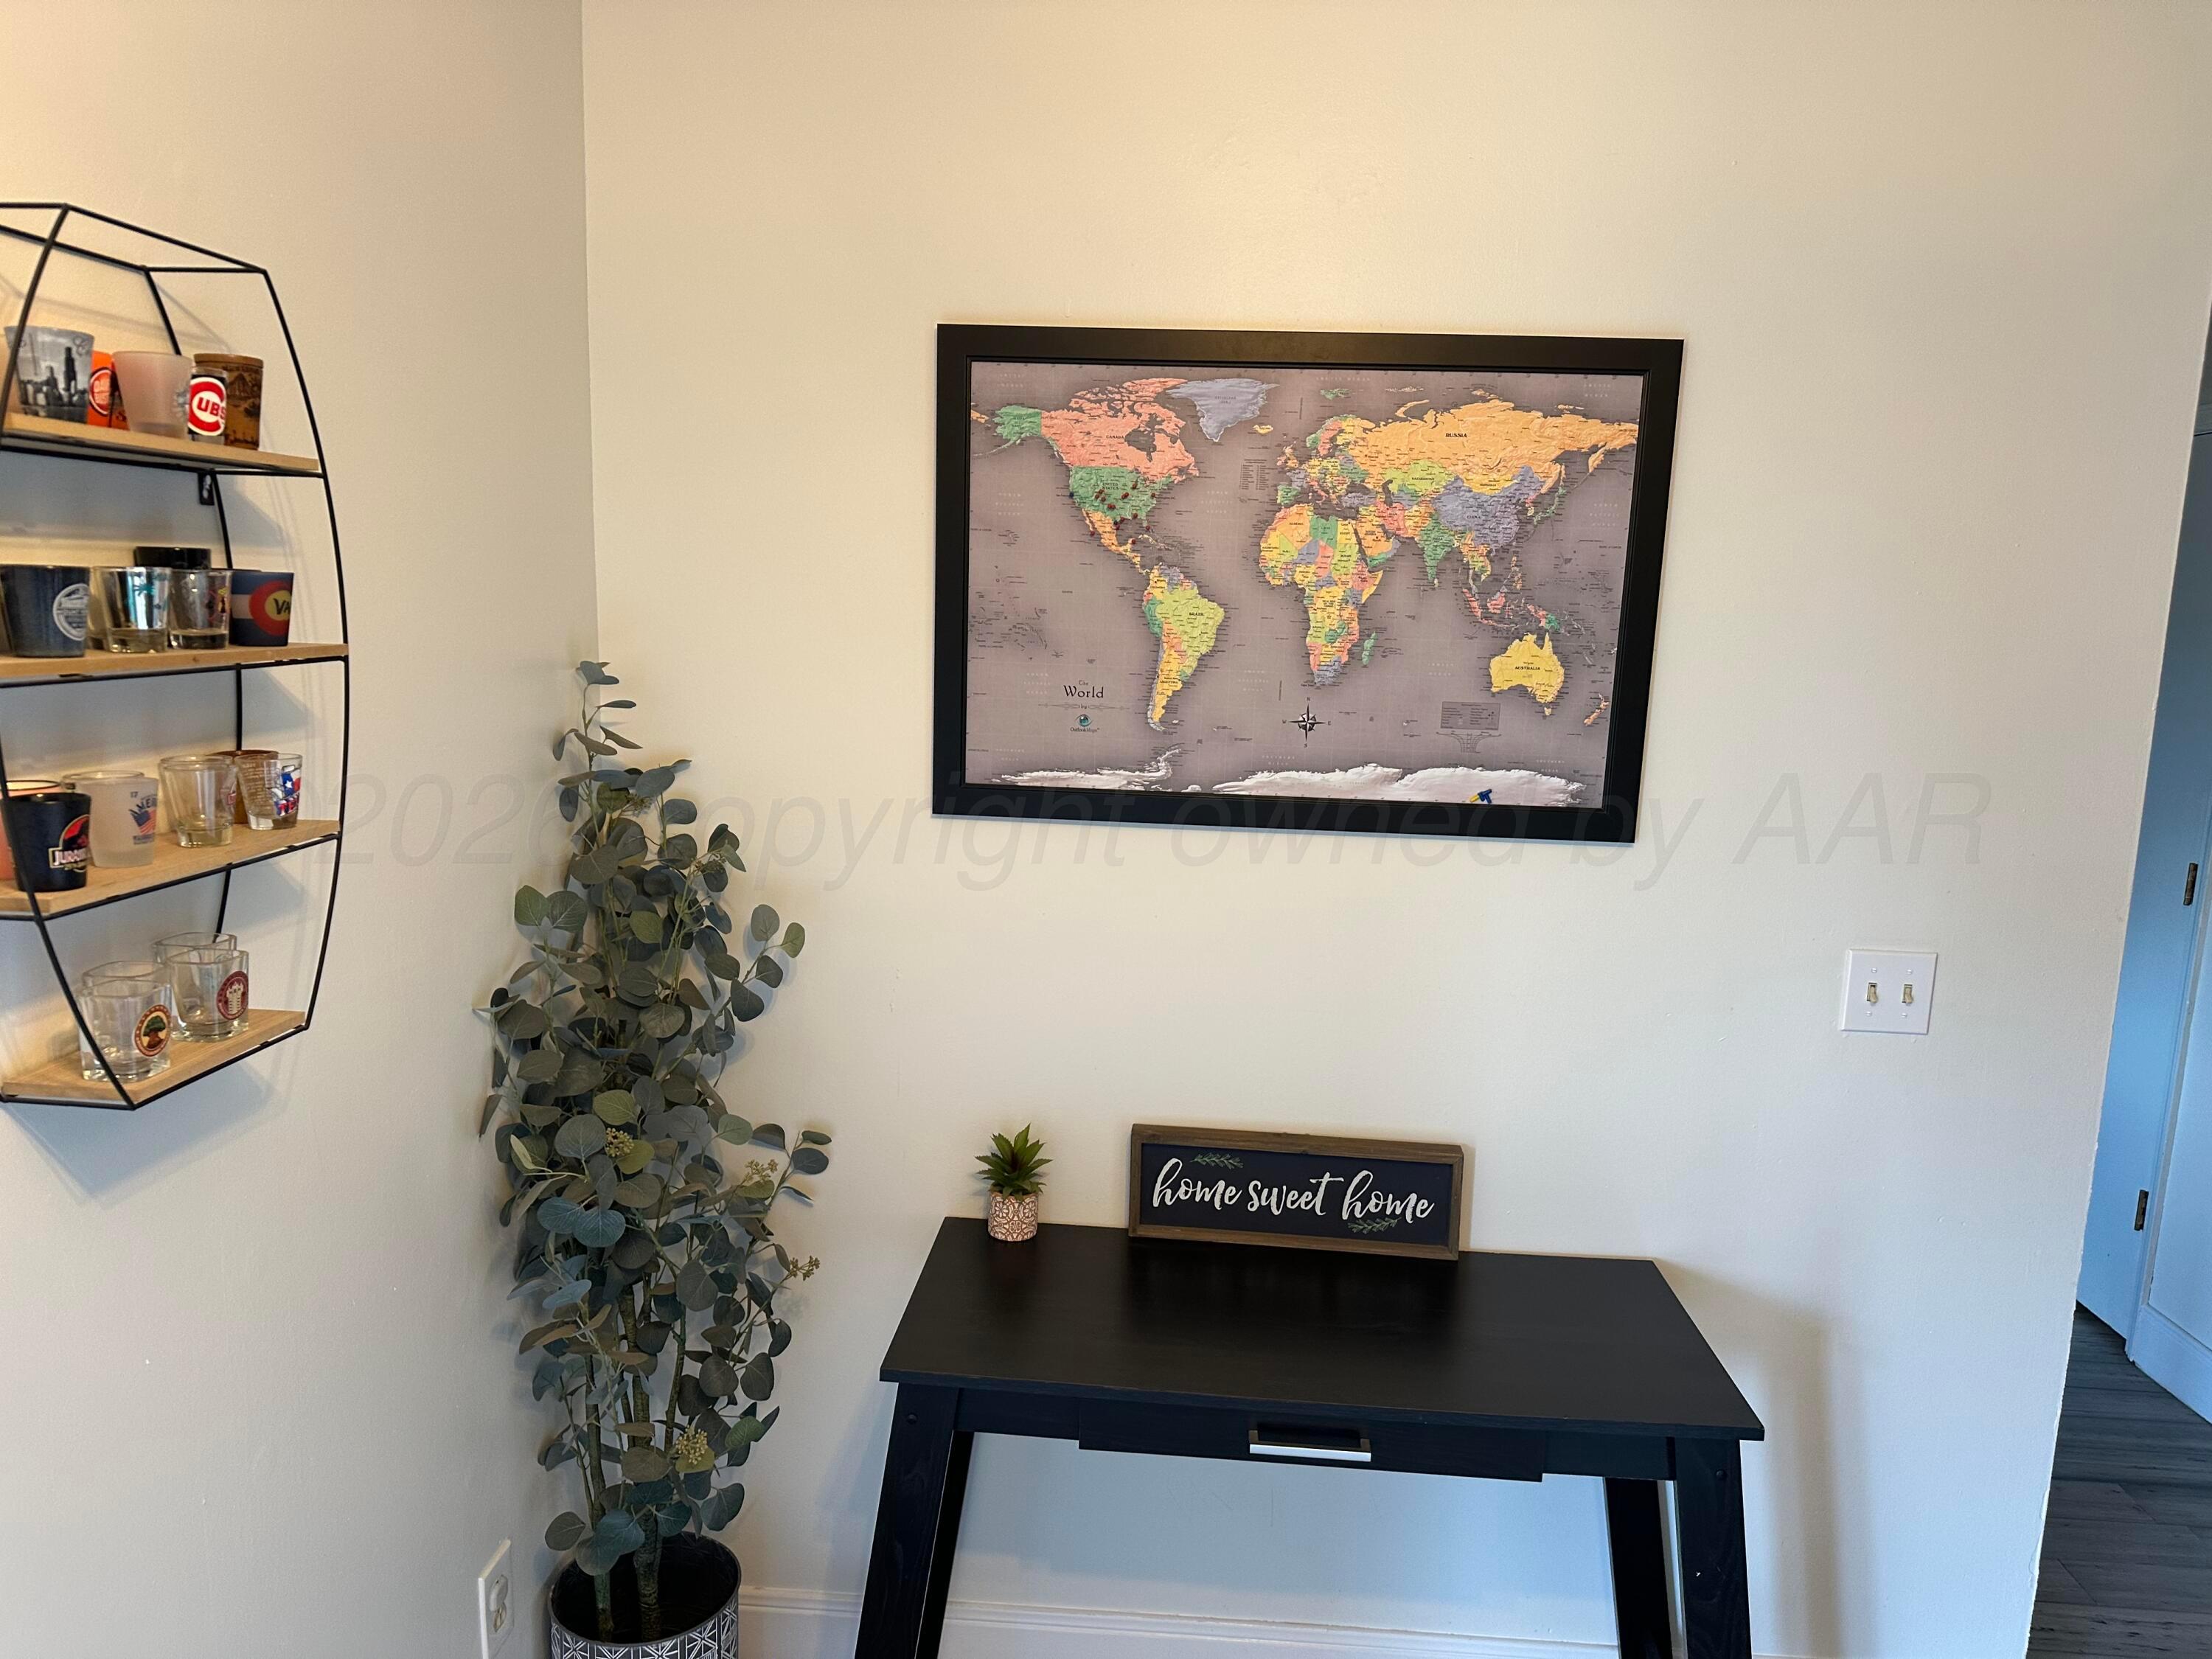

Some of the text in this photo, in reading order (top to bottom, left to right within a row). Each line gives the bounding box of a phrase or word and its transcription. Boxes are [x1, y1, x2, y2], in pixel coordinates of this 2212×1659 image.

[1063, 684, 1105, 698] World
[1152, 1157, 1435, 1224] home sweet home
